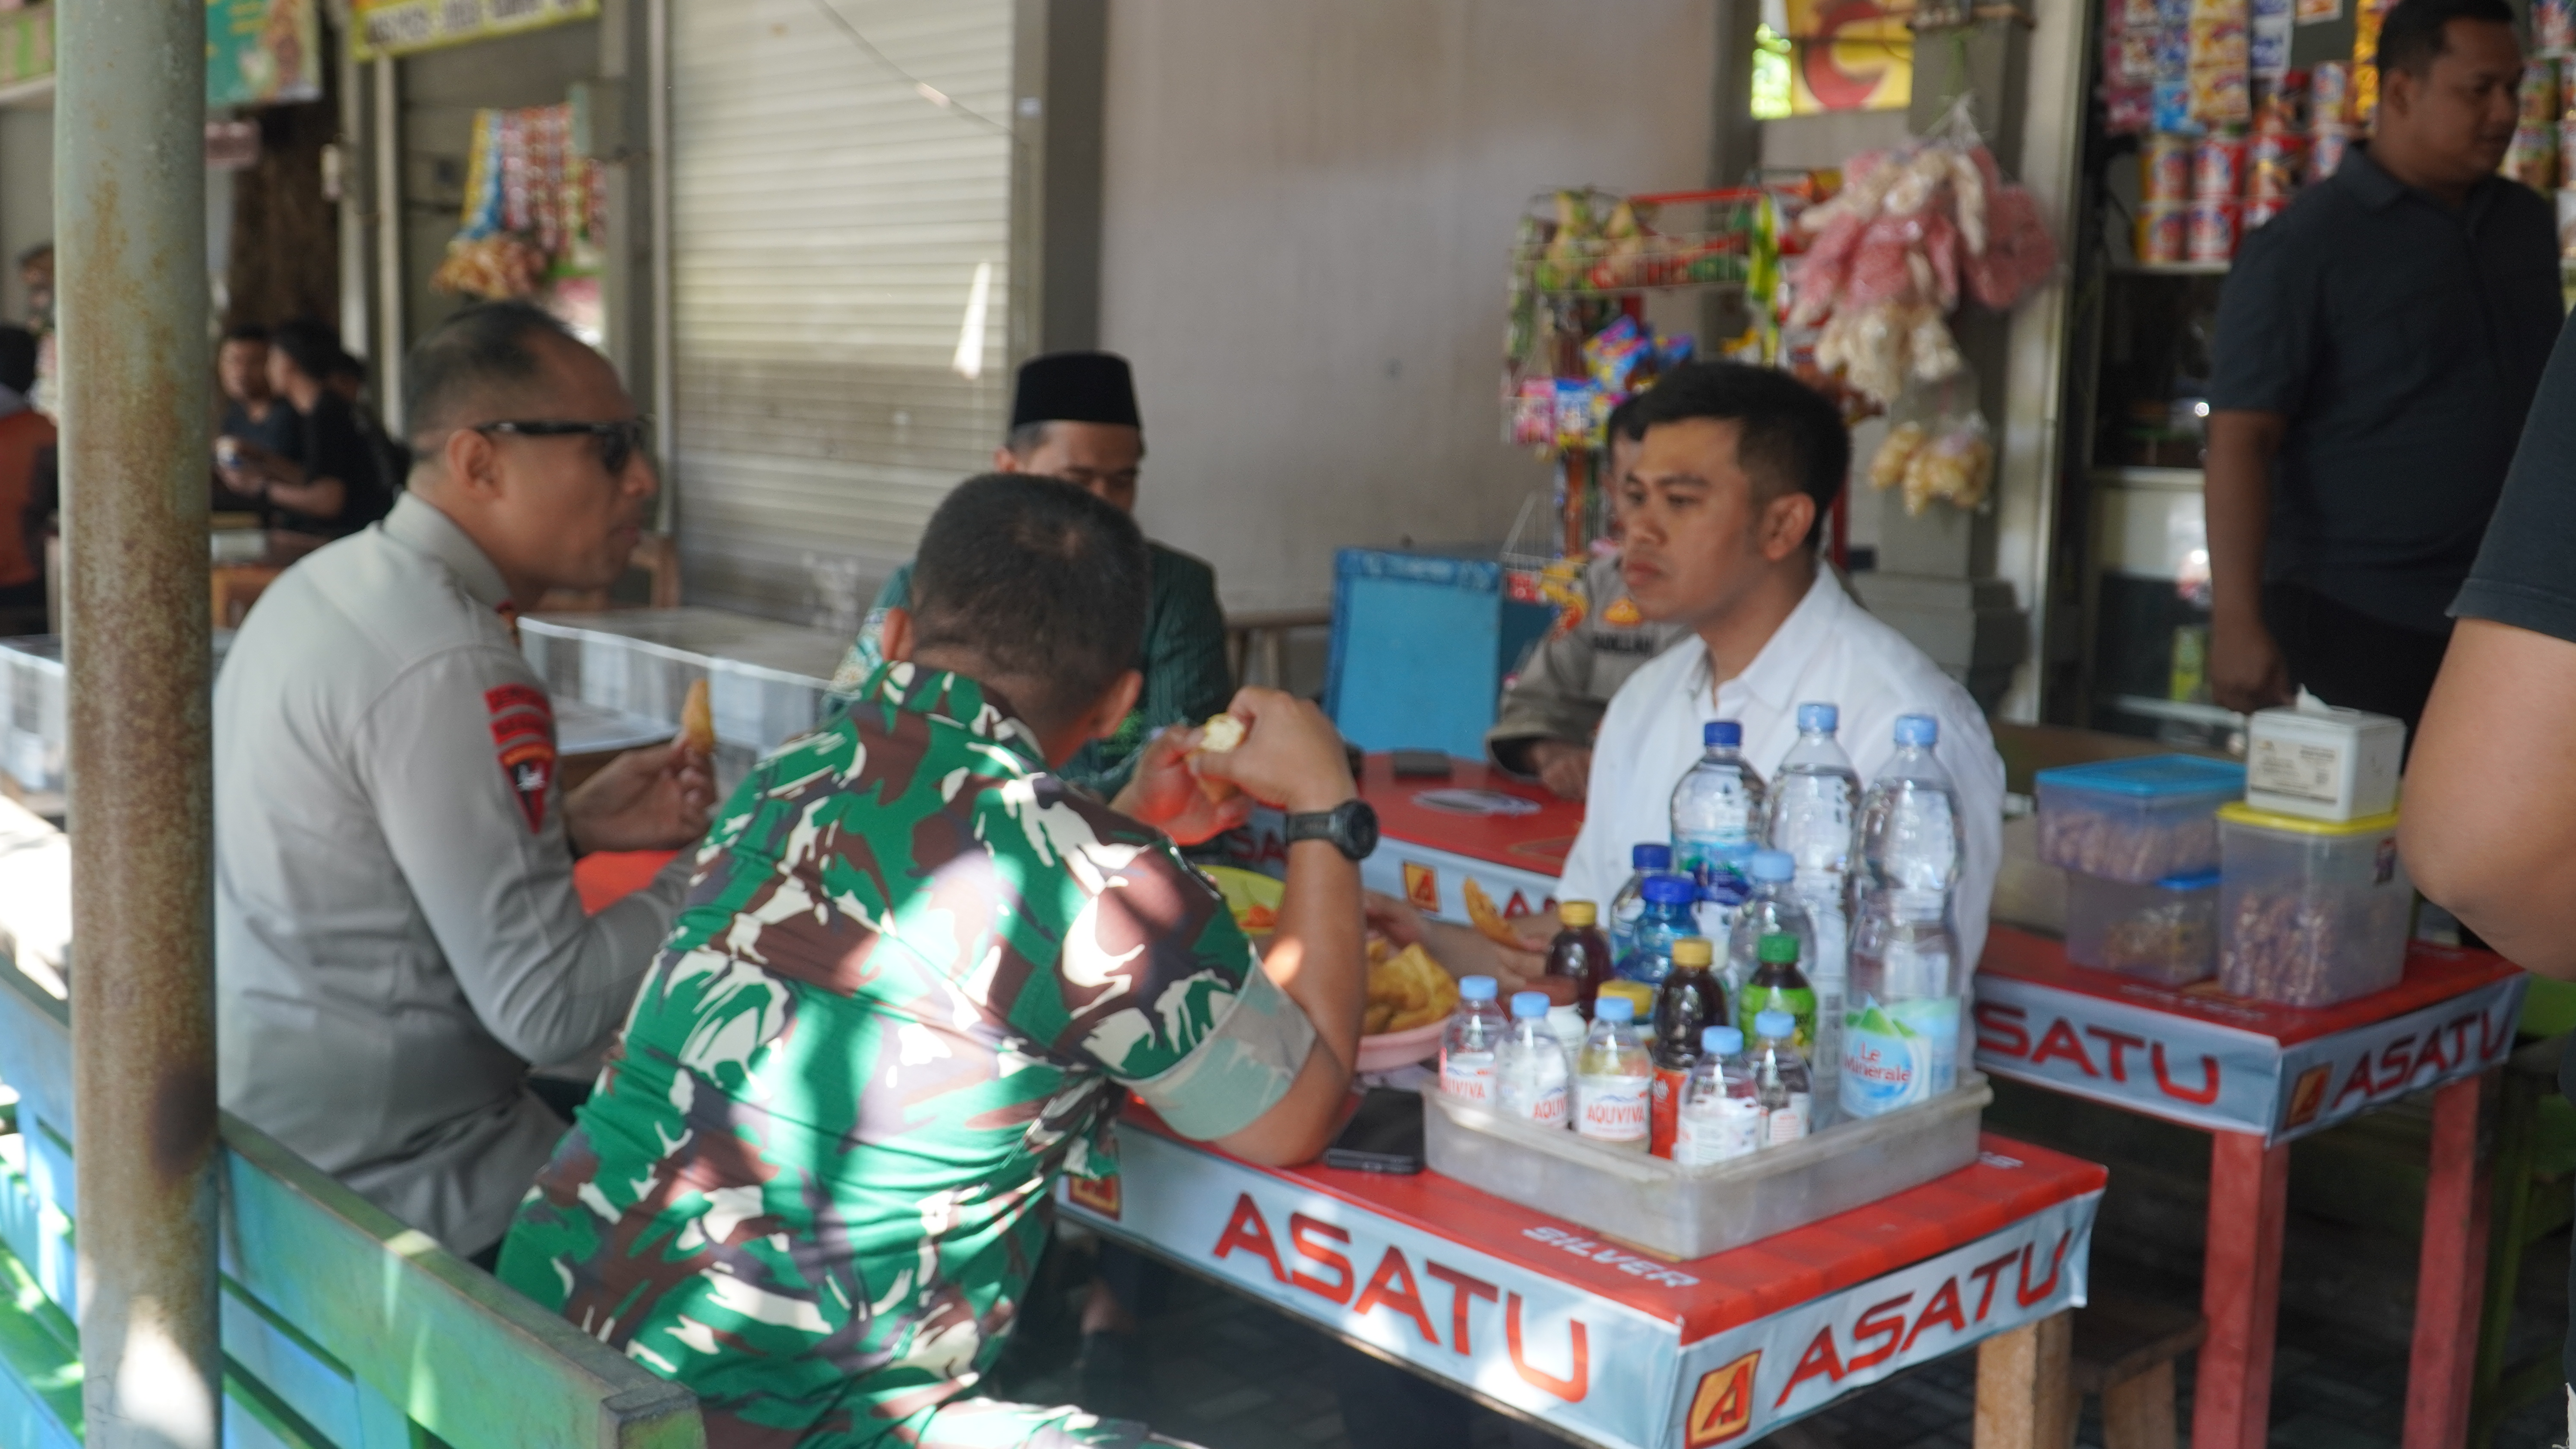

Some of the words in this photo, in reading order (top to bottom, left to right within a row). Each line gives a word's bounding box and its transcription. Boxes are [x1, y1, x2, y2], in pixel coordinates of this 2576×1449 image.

[1861, 1041, 1880, 1061] Le
[2331, 1007, 2515, 1107] ASATU
[1587, 1103, 1645, 1125] AQUVIVA
[1522, 1225, 1701, 1288] SILVER
[1212, 1191, 1589, 1404] ASATU
[1773, 1228, 2072, 1410] ASATU
